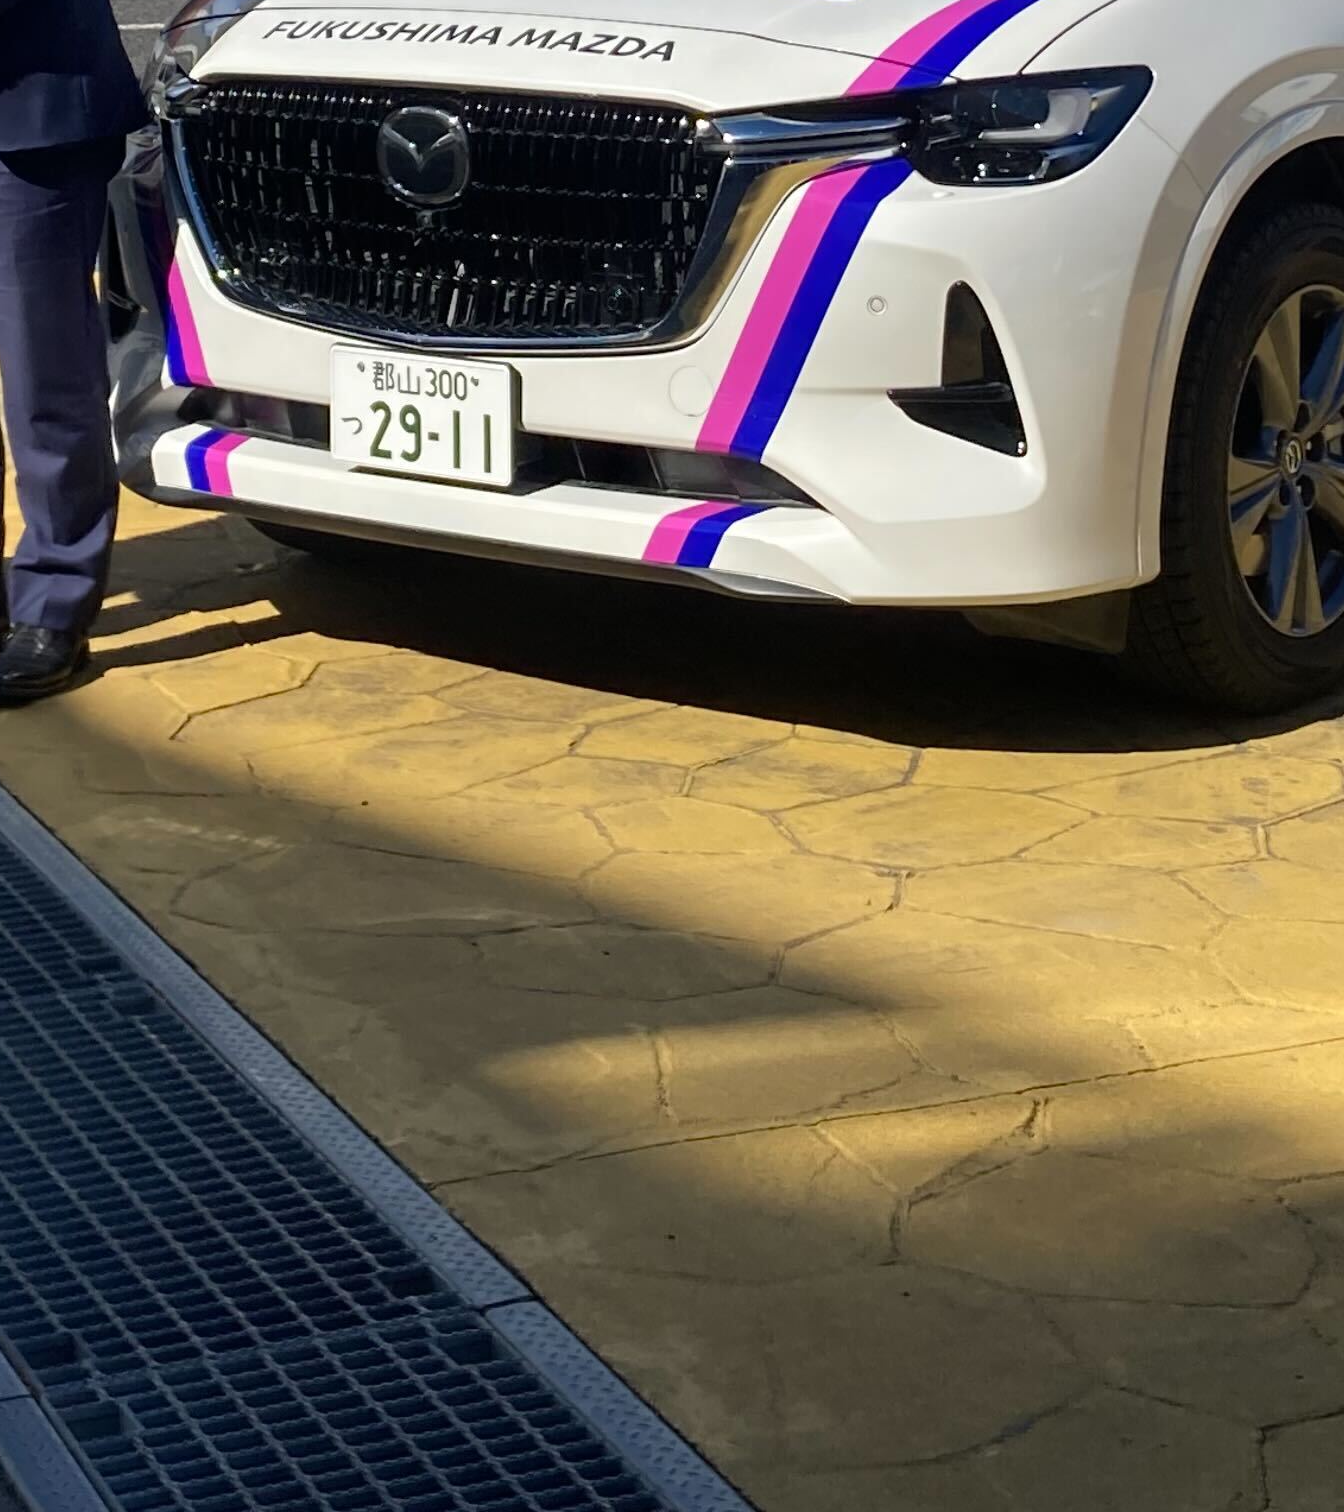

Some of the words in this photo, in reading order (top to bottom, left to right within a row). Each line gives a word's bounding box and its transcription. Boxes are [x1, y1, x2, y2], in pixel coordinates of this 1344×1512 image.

[262, 20, 503, 46] FUKUSHIMA
[506, 27, 677, 62] MAZDA
[368, 400, 492, 474] 29-11
